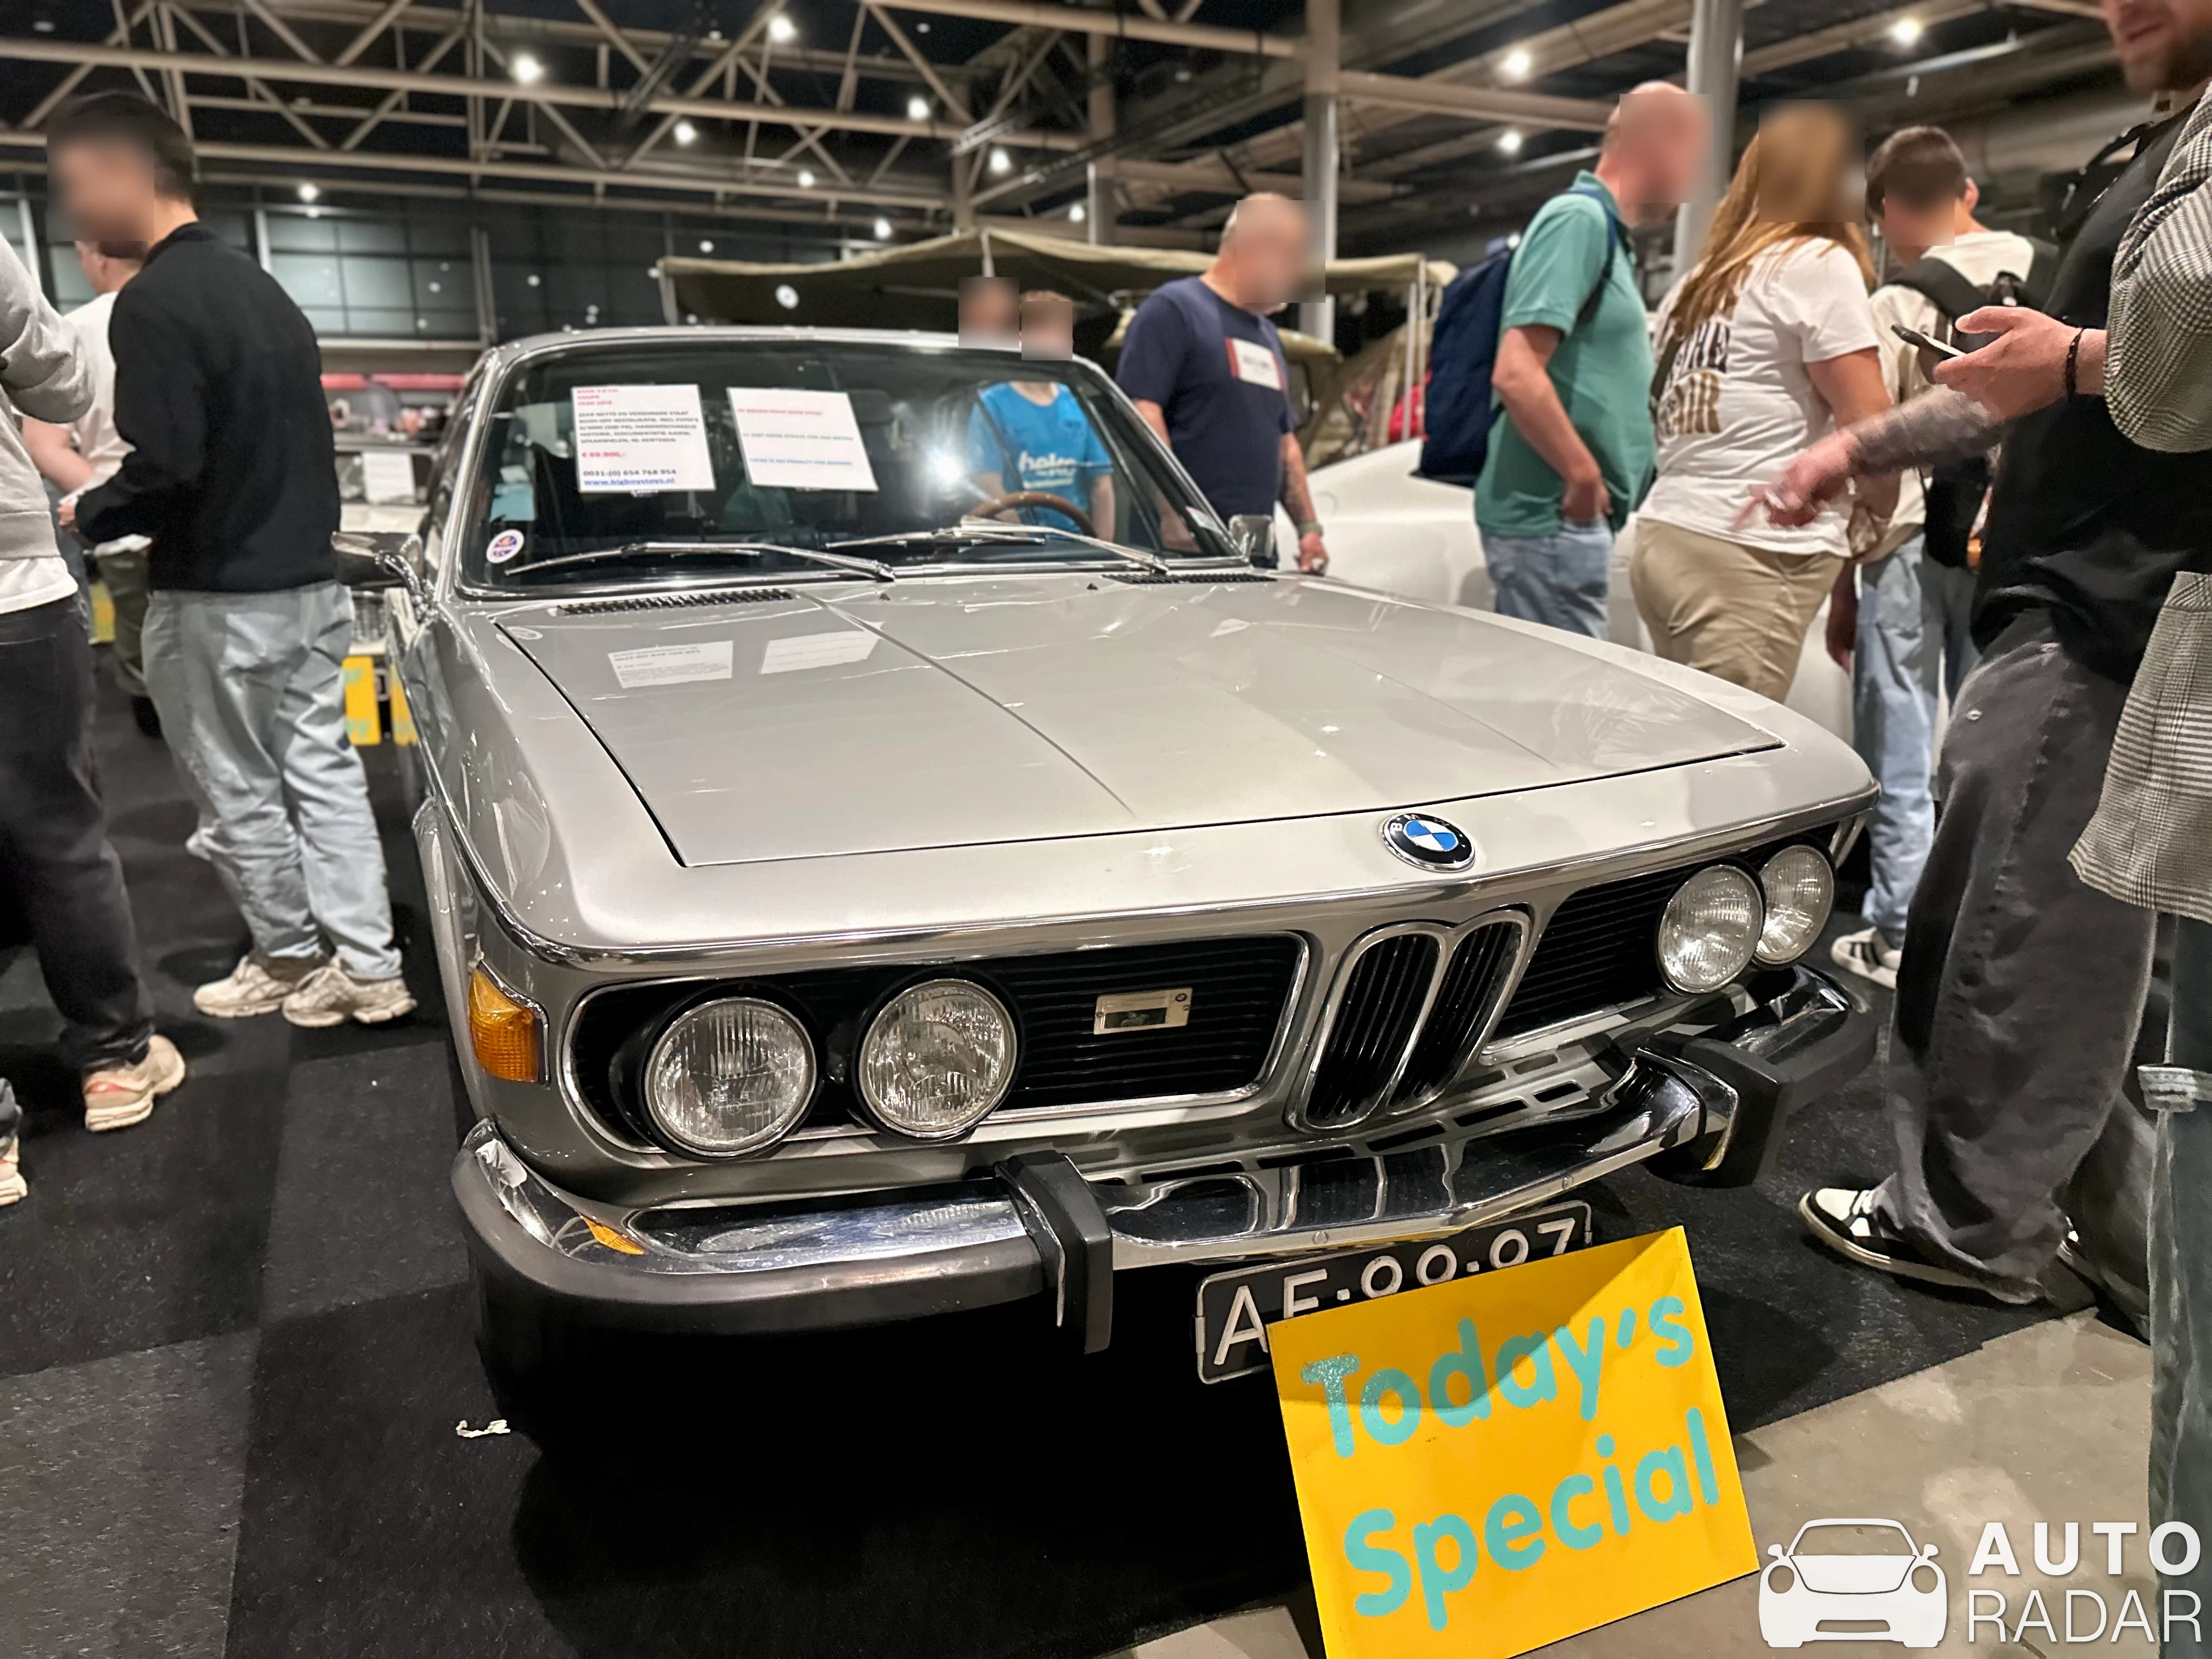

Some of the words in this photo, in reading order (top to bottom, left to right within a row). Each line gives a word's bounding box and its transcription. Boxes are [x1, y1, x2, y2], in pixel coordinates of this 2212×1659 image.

[1390, 814, 1451, 833] BMW
[1300, 1296, 1695, 1459] Today's
[1344, 1407, 1720, 1632] Special
